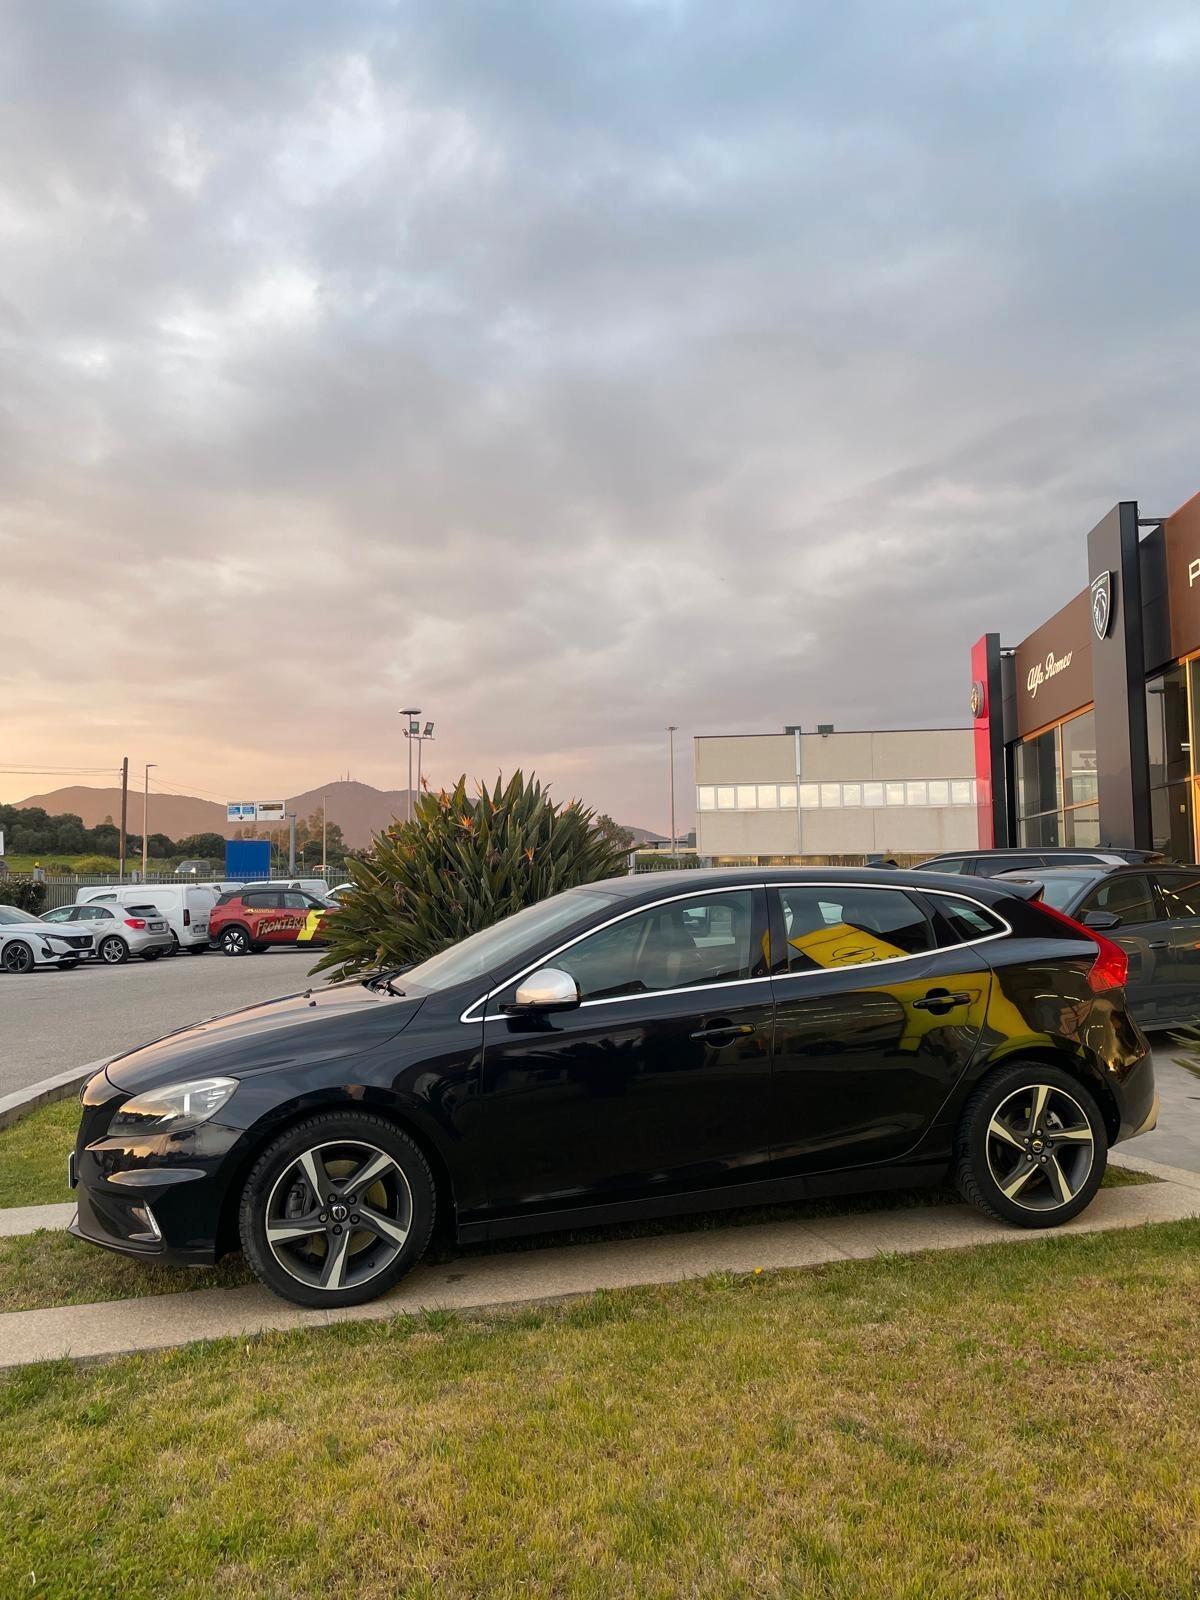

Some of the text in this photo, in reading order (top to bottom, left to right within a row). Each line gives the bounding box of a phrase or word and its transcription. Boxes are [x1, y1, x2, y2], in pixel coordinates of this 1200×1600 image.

[1027, 651, 1072, 698] Alfa Romeo
[256, 917, 307, 938] FRONTERA
